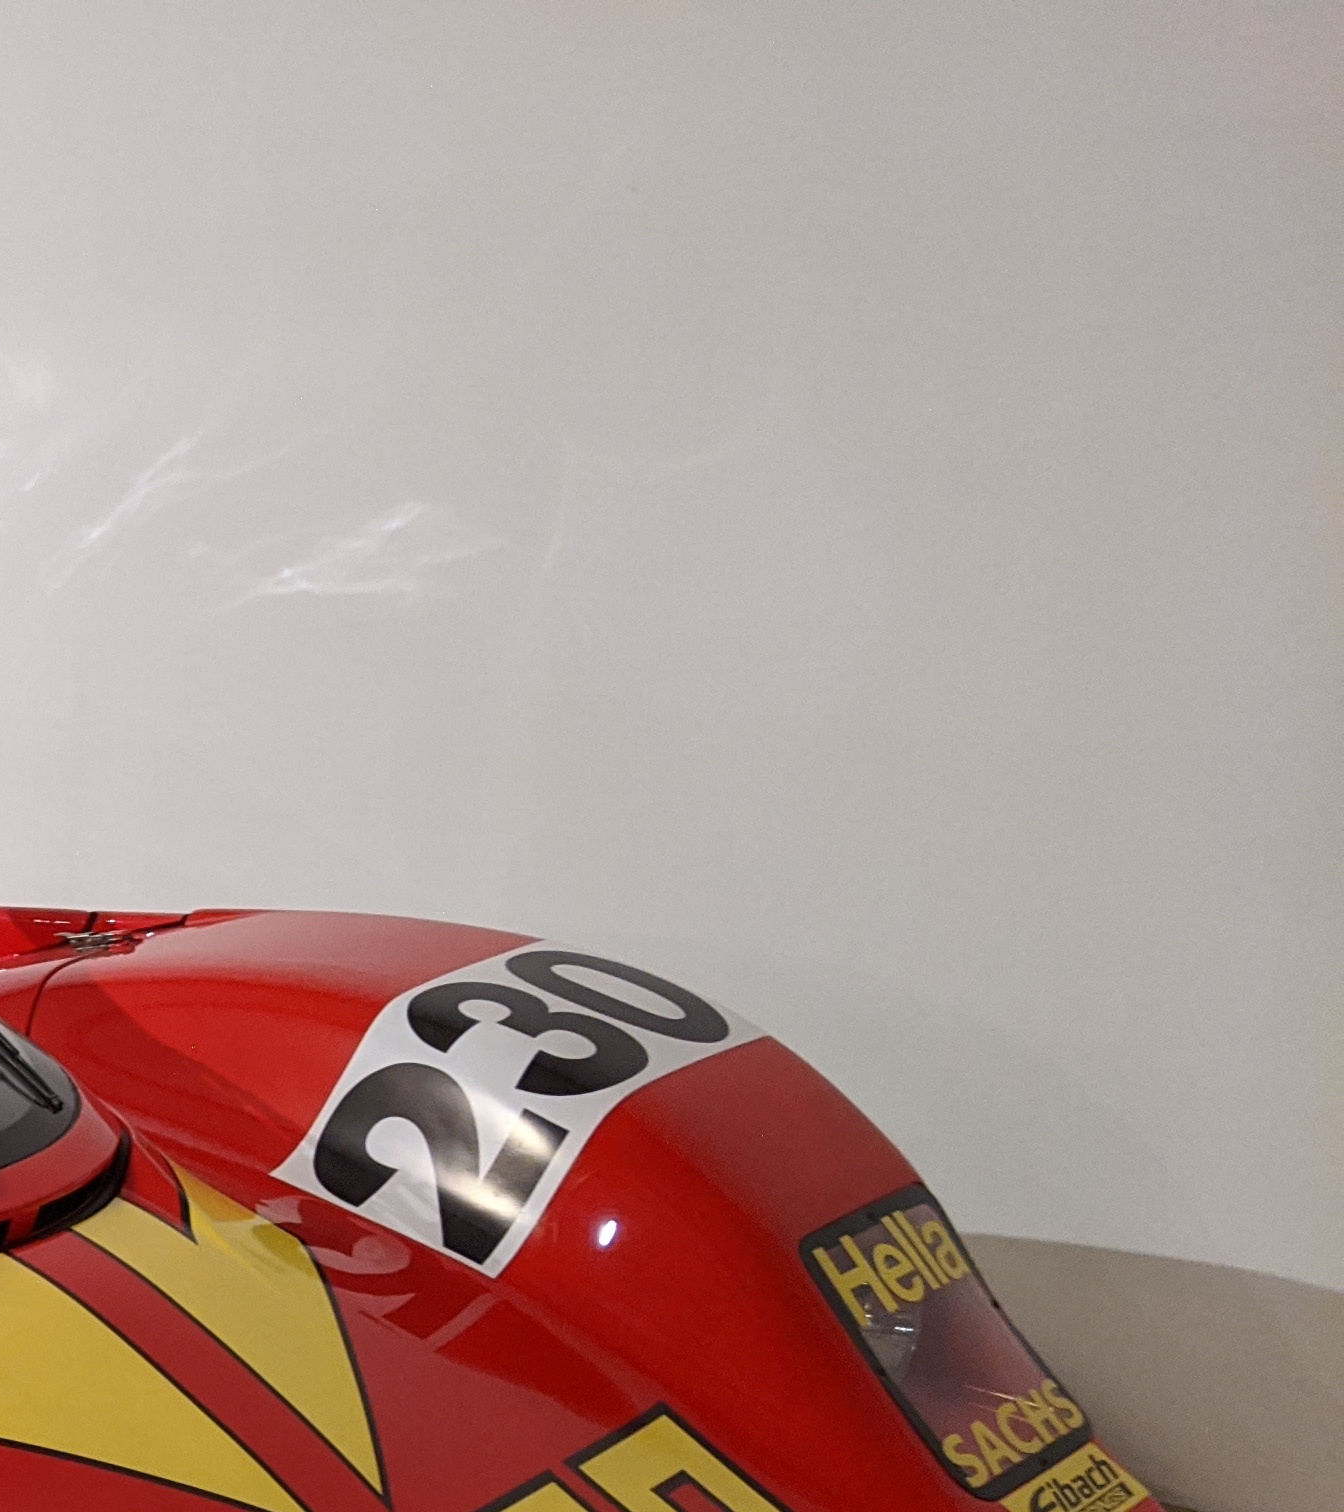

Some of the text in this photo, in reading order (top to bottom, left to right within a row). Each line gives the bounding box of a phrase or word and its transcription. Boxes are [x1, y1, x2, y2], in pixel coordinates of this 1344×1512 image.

[313, 950, 729, 1265] 230
[812, 1210, 970, 1328] Hella
[942, 1378, 1086, 1488] SACHS
